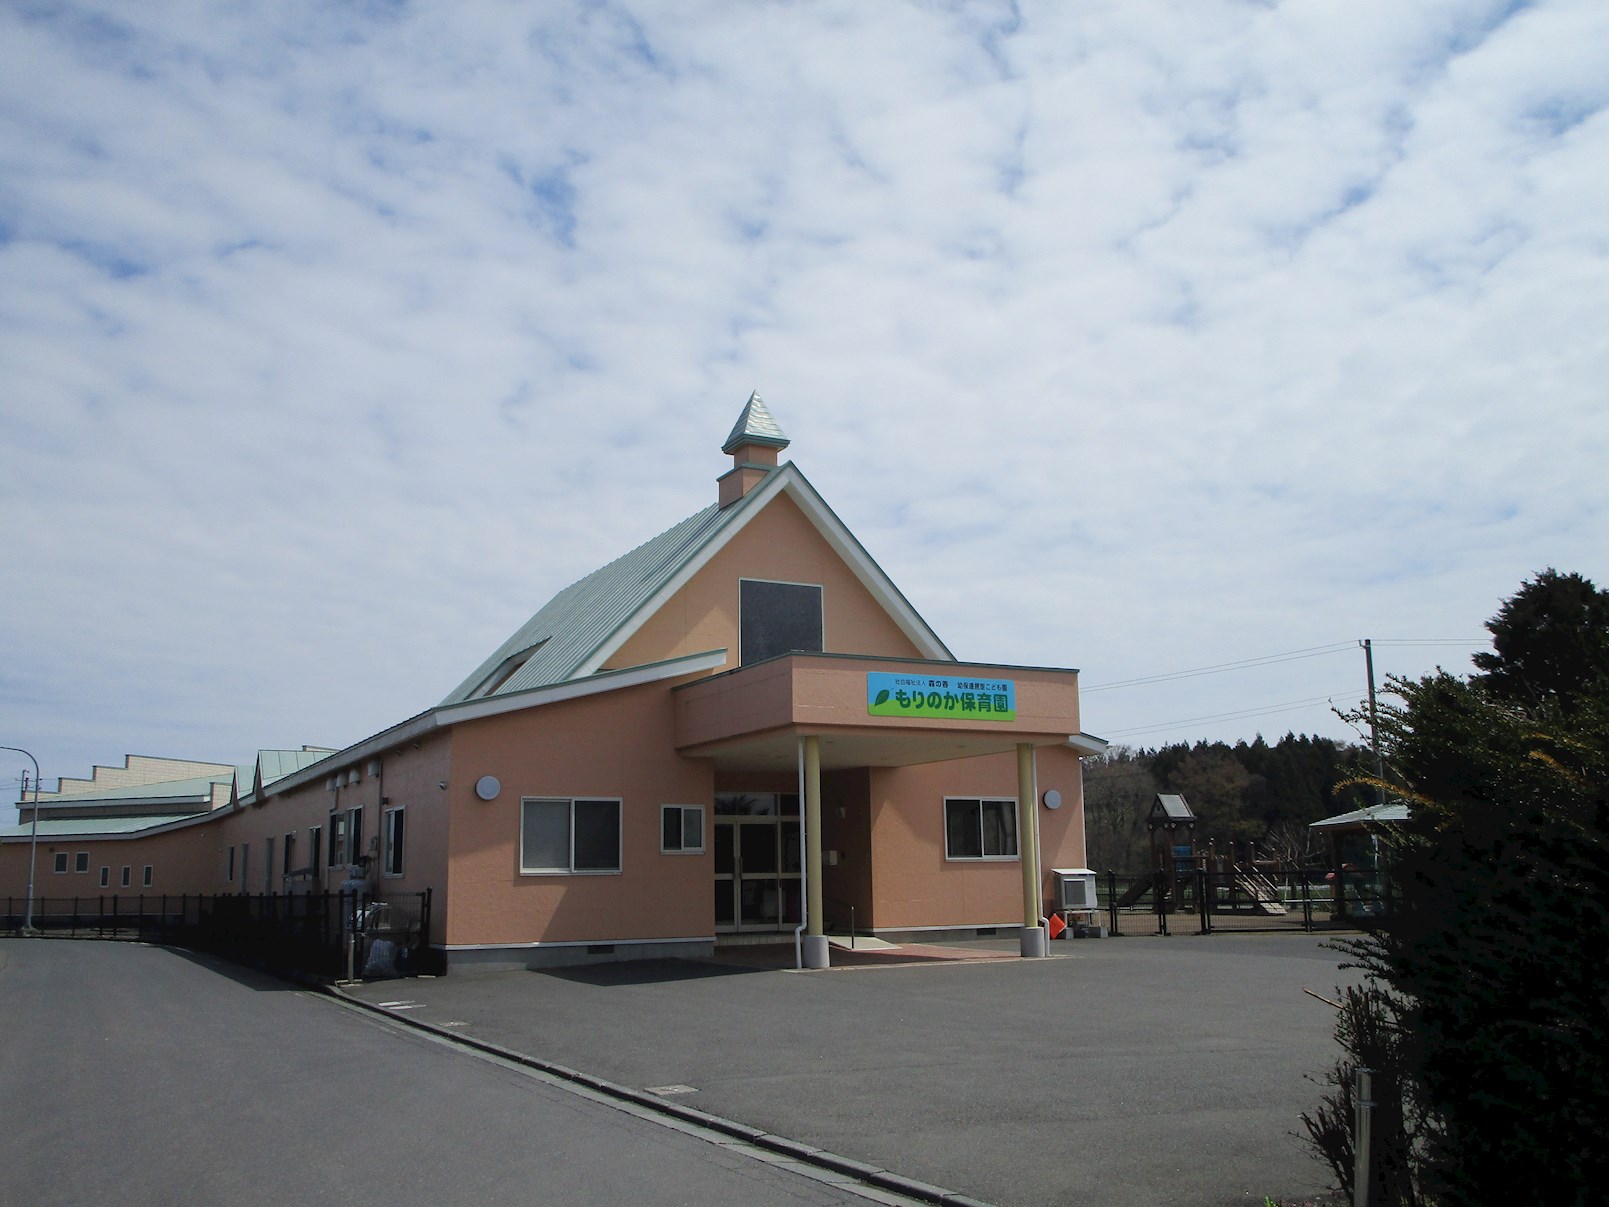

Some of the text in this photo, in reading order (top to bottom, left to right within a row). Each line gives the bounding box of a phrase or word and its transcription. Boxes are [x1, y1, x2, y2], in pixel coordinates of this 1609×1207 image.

[895, 689, 1009, 712] もりのか保育園
